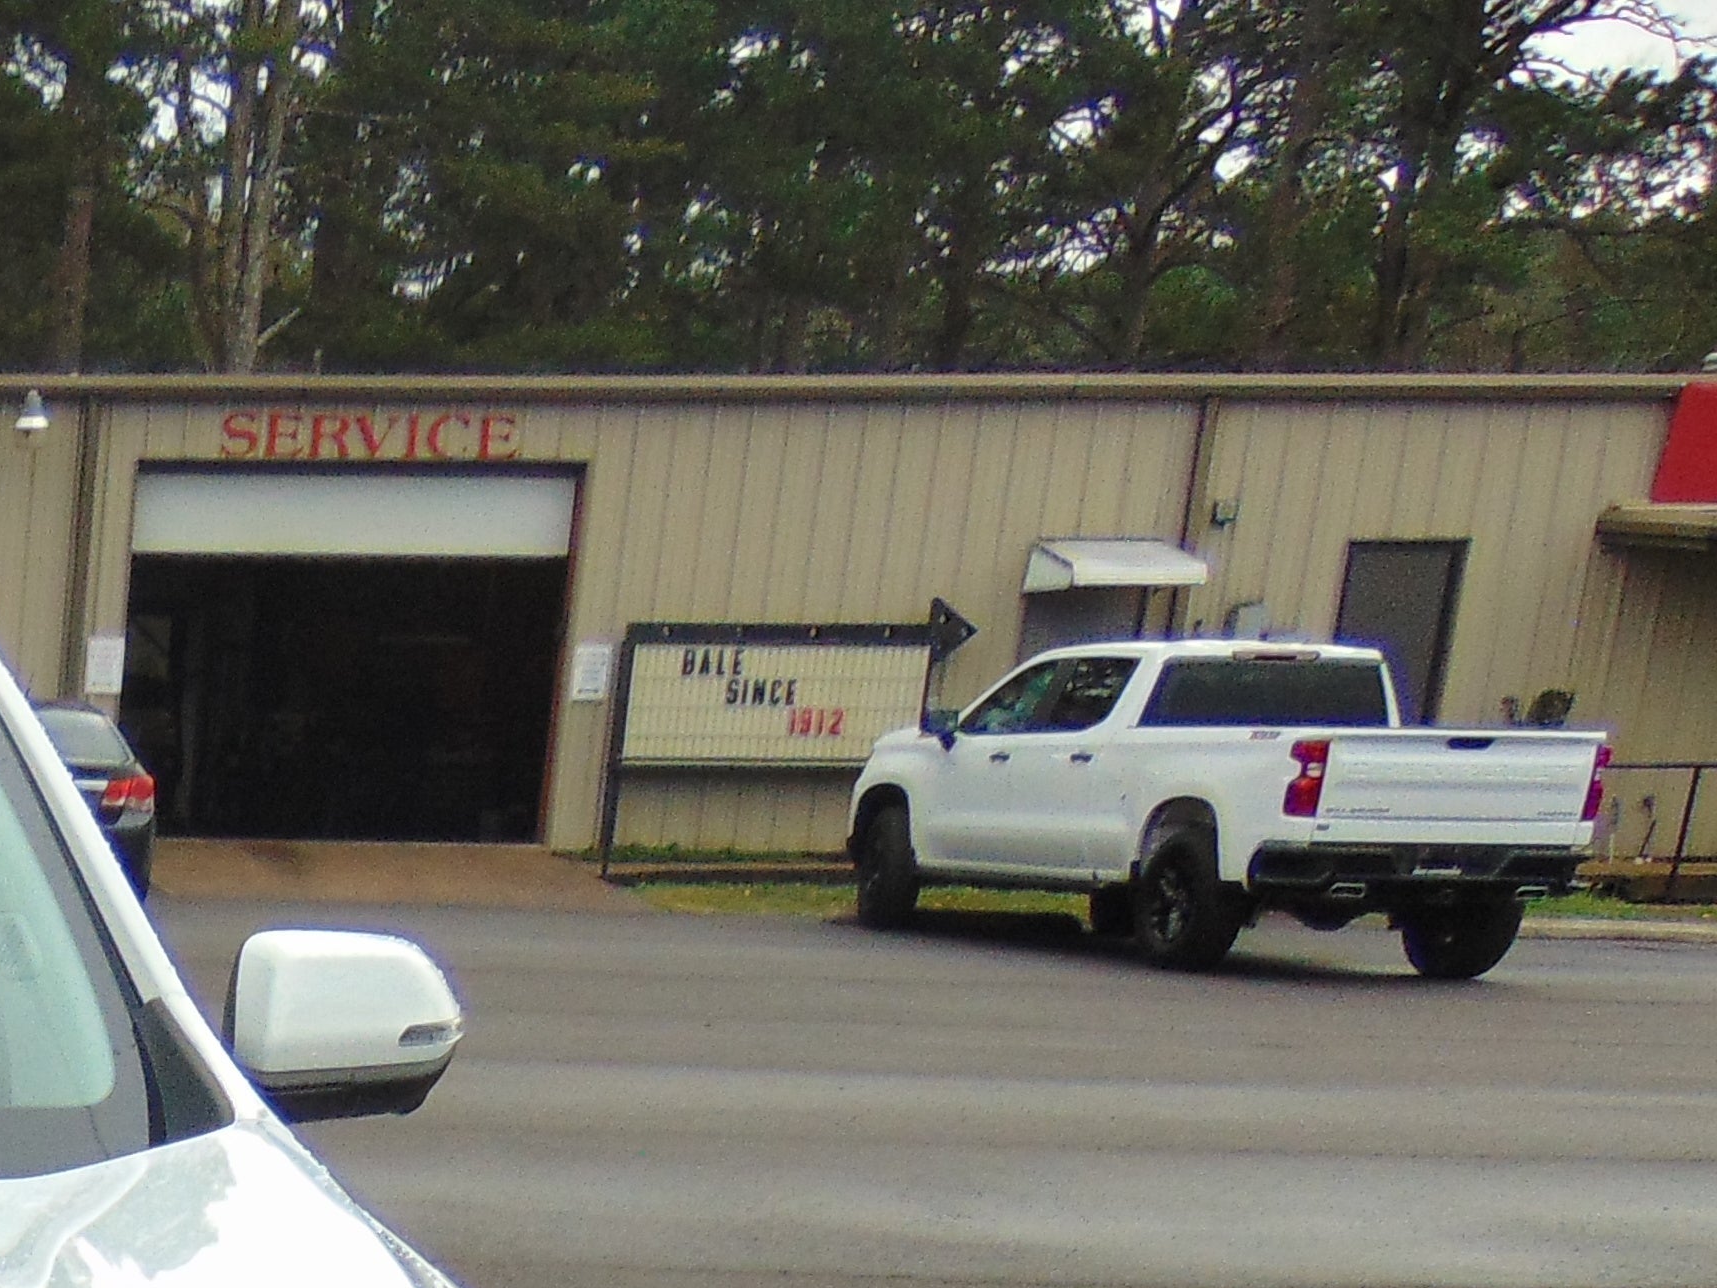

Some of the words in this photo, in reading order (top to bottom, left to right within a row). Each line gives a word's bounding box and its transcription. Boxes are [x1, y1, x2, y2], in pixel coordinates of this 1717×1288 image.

[221, 411, 520, 460] SERVICE
[725, 678, 797, 706] SINCE
[788, 707, 844, 737] 1912
